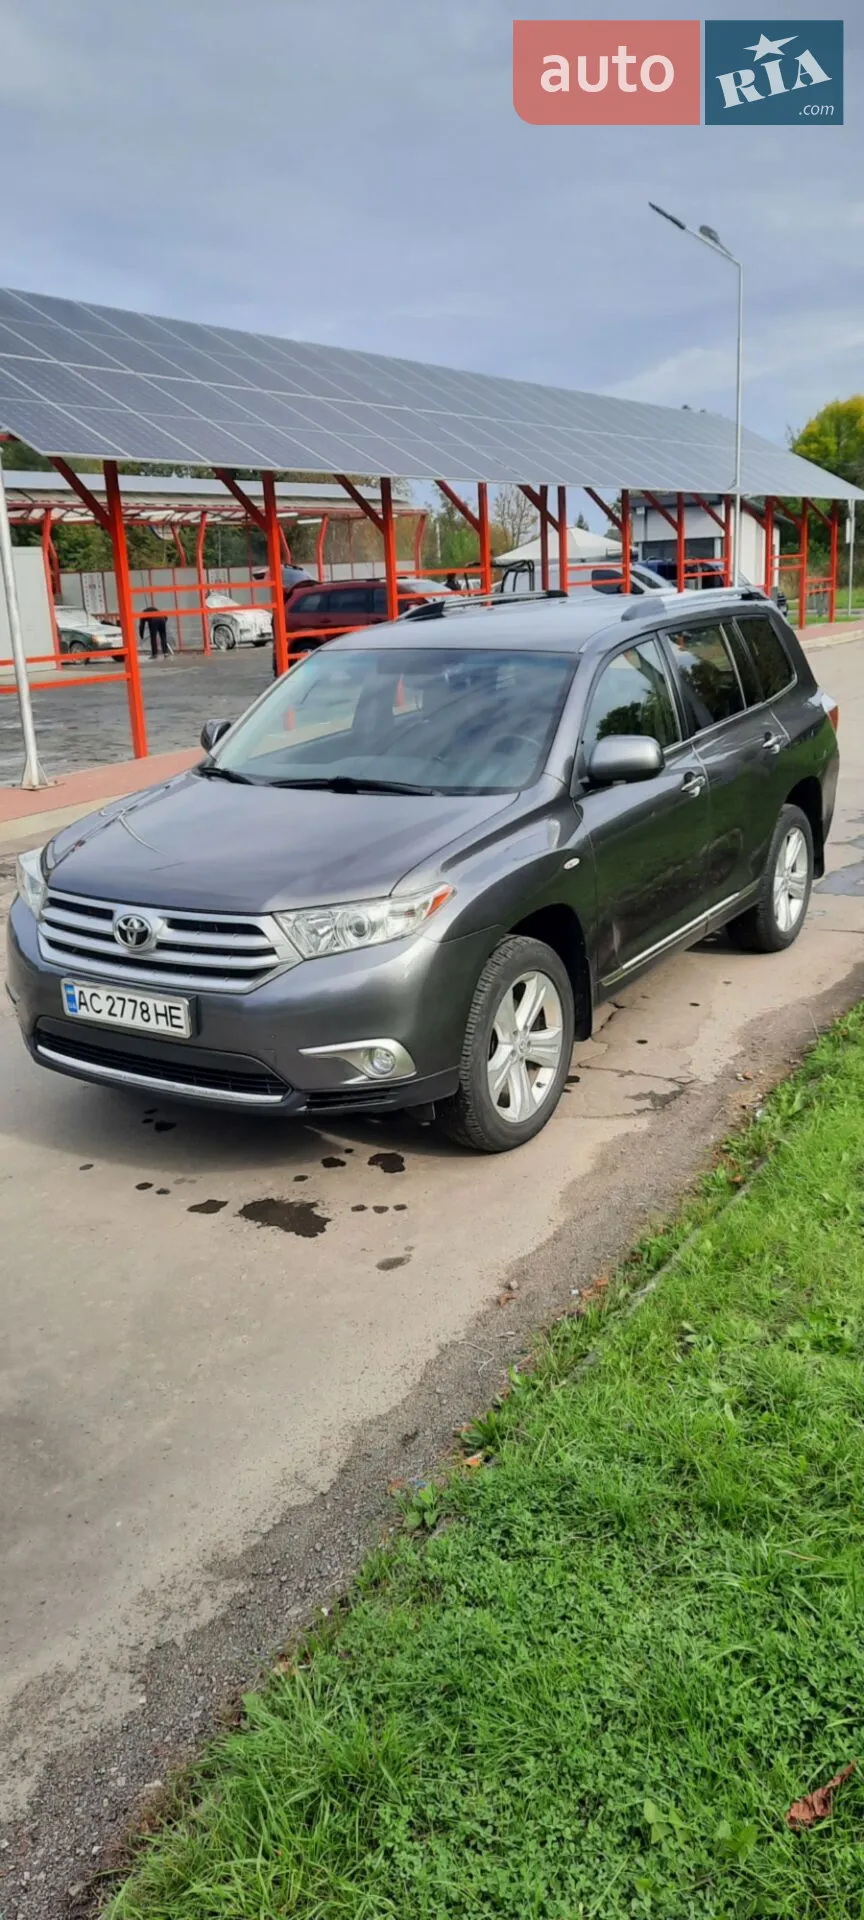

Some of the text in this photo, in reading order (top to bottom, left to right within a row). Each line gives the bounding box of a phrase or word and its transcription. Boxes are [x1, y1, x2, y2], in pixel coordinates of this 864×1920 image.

[78, 990, 184, 1029] AC 2778 HE
